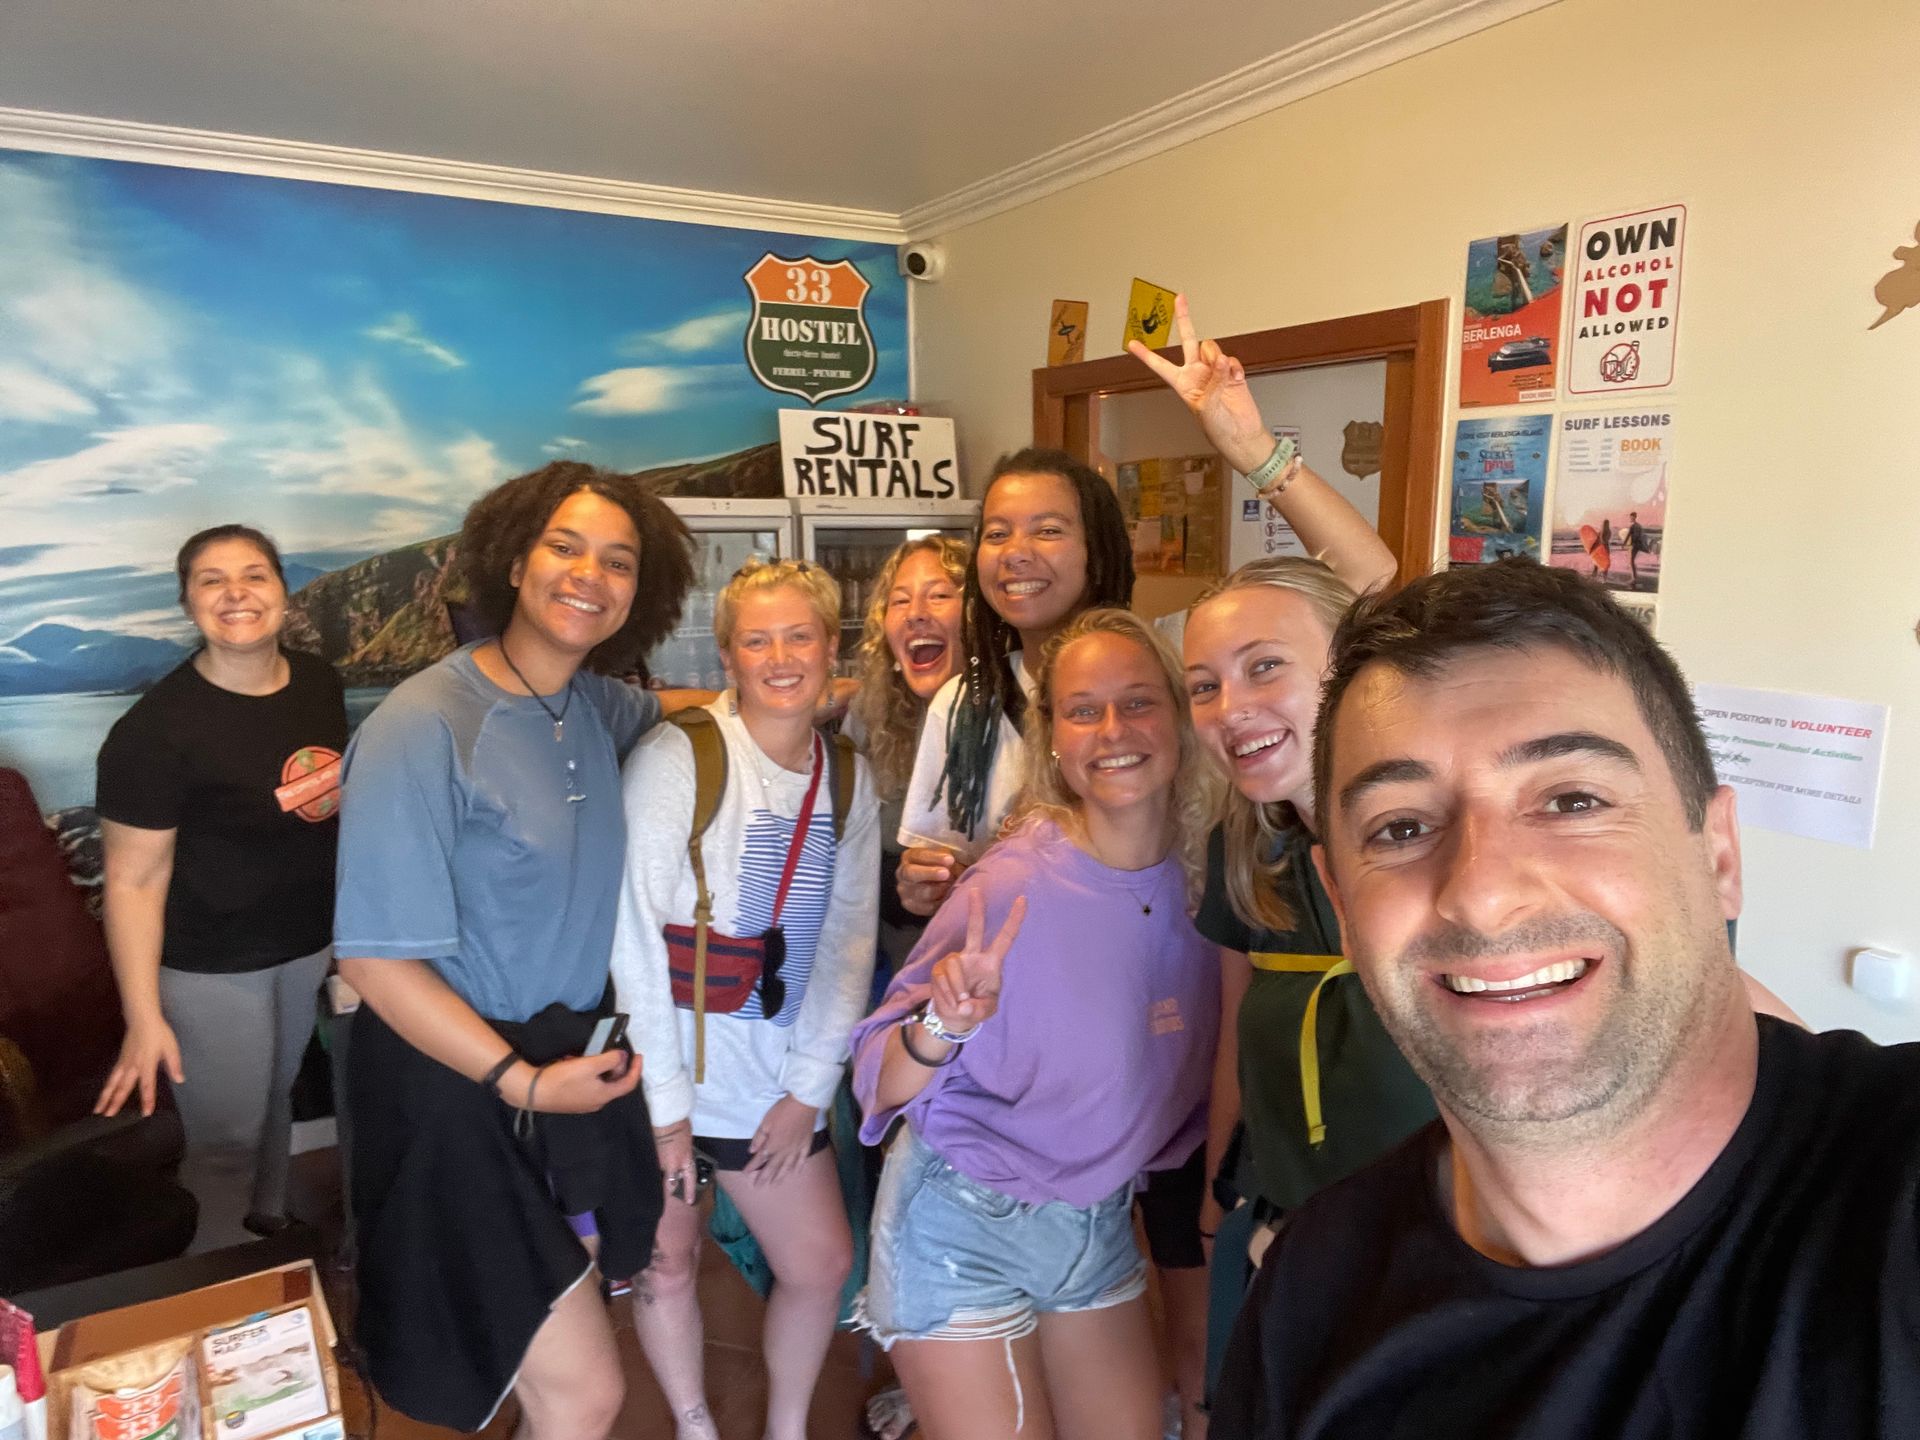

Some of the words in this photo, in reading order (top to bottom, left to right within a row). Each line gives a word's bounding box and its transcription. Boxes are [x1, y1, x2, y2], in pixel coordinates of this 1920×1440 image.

[1586, 217, 1677, 260] OWN
[1583, 256, 1674, 282] ALCOHOL
[786, 267, 832, 304] 33
[1583, 278, 1668, 318] NOT
[761, 317, 861, 345] HOSTEL
[1463, 323, 1522, 344] BERLENGA
[1579, 316, 1669, 339] ALLOWED
[1565, 418, 1600, 431] SURF
[1604, 413, 1671, 429] LESSONS
[805, 417, 920, 459] SURF
[1621, 438, 1662, 452] BOOK
[793, 458, 955, 499] RENTALS
[1703, 709, 1728, 719] OPEN
[1729, 712, 1773, 725] POSITION
[1774, 717, 1788, 727] TO
[1791, 719, 1873, 738] VOLUNTEER
[1811, 748, 1863, 761] Activities
[213, 1325, 268, 1348] SURFER
